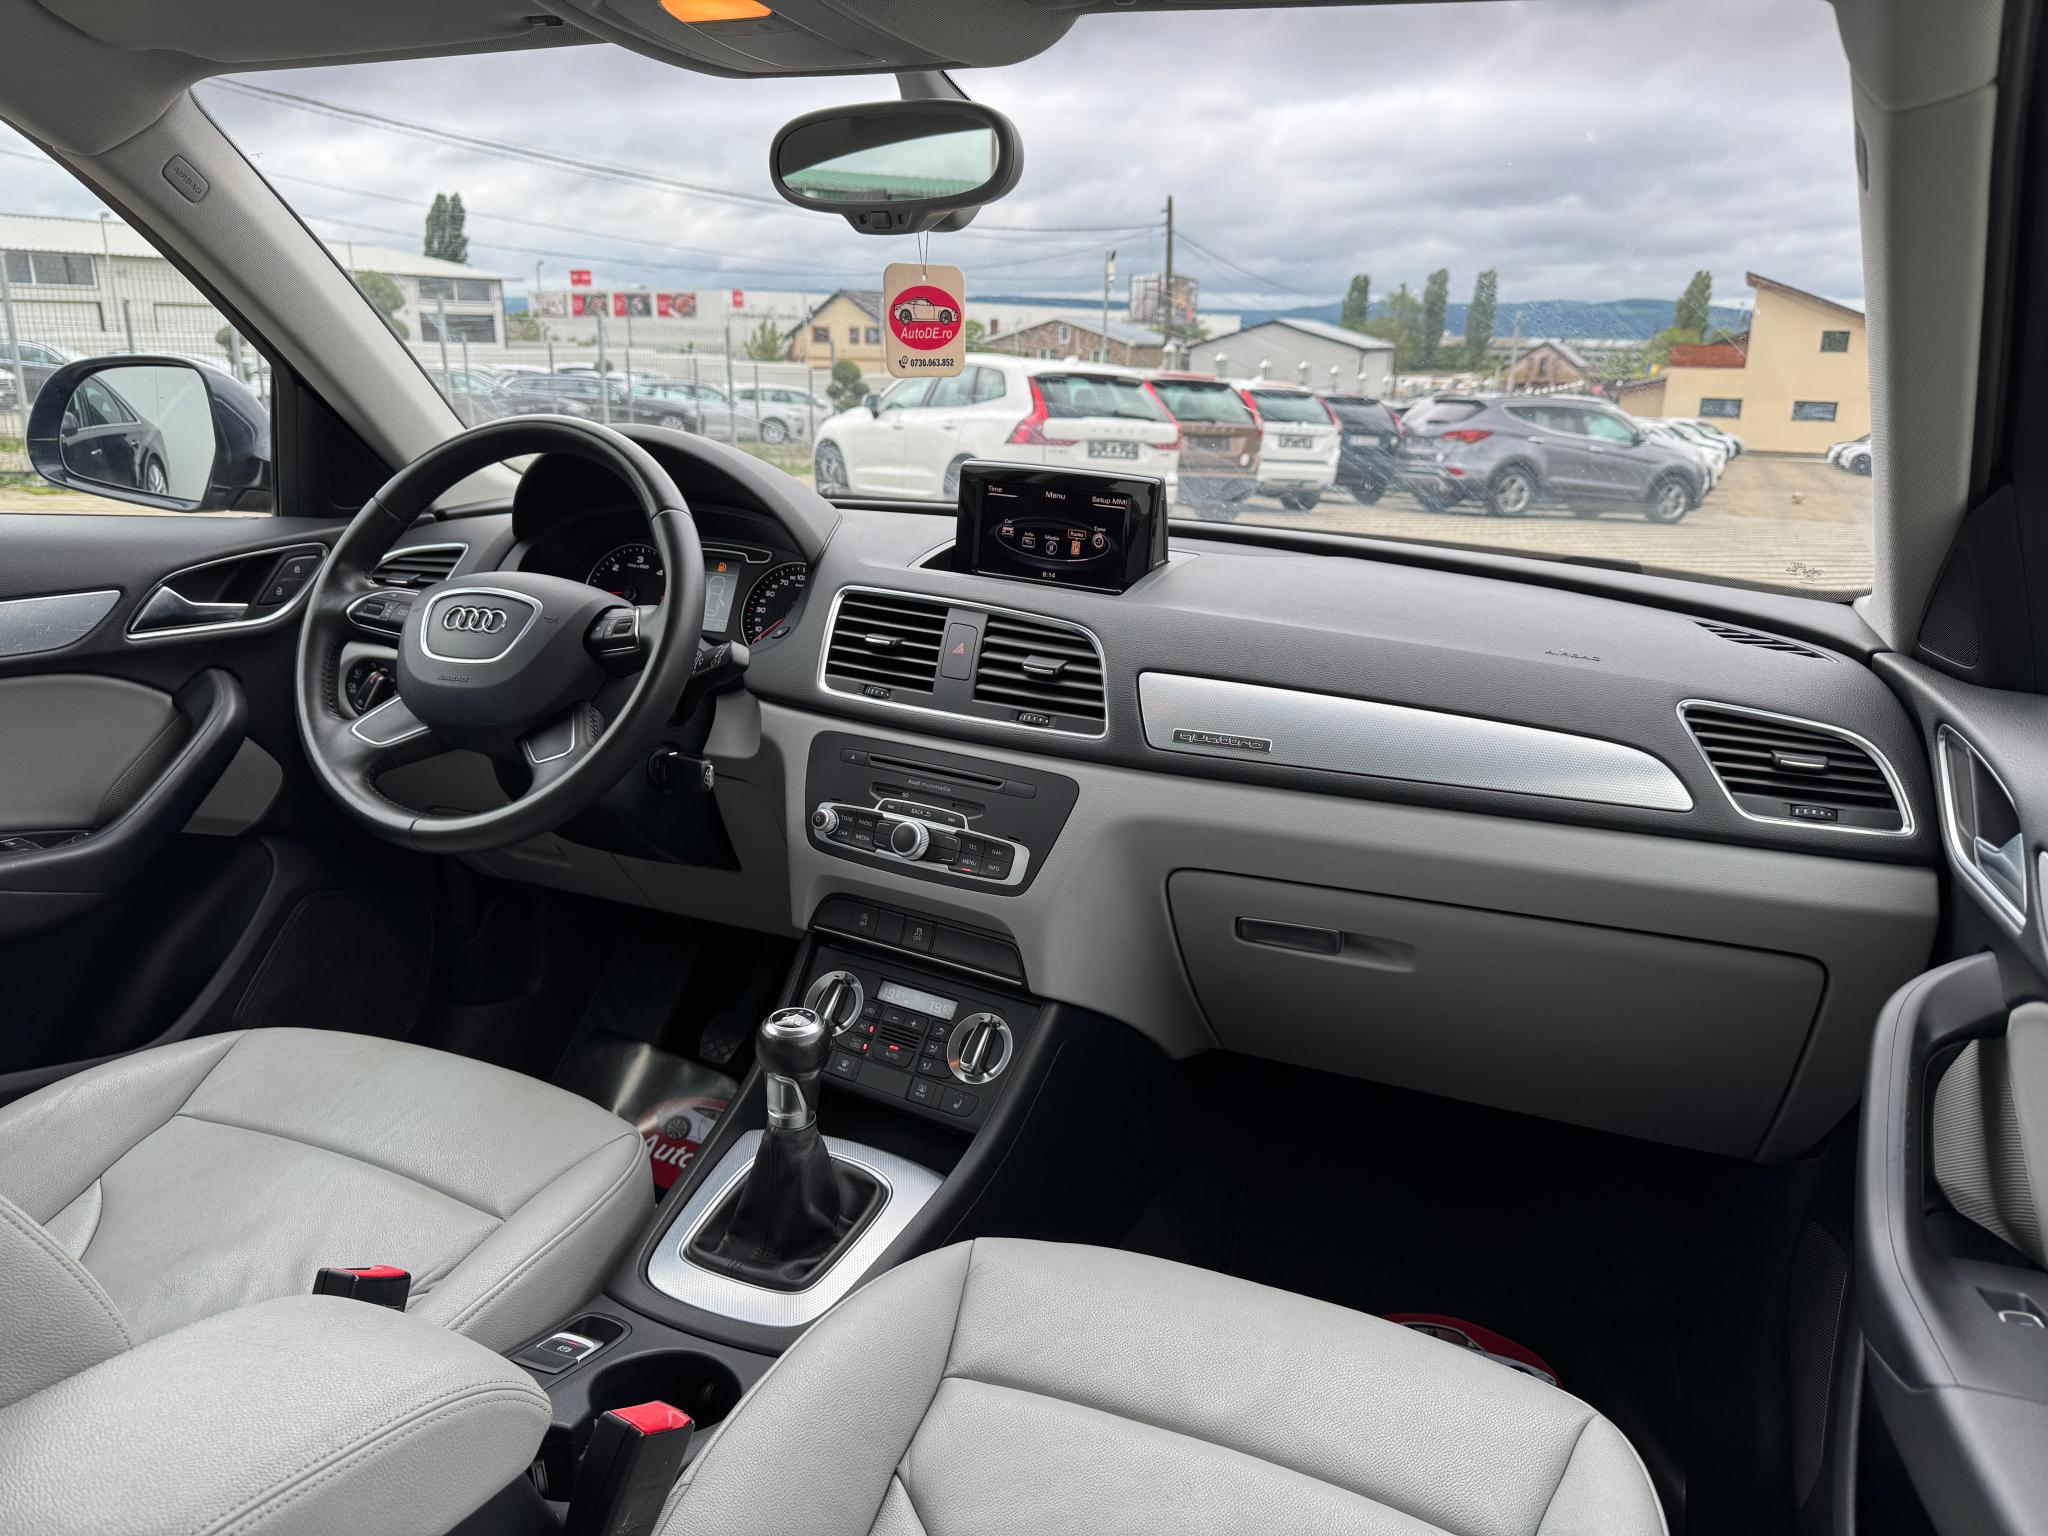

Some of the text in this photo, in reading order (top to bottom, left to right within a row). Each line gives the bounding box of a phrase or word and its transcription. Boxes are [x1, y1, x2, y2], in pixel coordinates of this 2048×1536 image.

[173, 167, 202, 194] AIRBAG
[900, 326, 953, 339] AutoDE.ro
[910, 358, 954, 367] 0730.063.852
[988, 485, 1003, 493] Time
[1045, 491, 1066, 500] Menu
[1091, 495, 1111, 505] Setup
[1094, 525, 1107, 533] Tone
[1044, 534, 1060, 542] Media
[636, 555, 644, 563] 3
[612, 563, 620, 572] 2
[1042, 570, 1056, 579] 8:14
[1180, 732, 1264, 749] quattro
[911, 808, 924, 816] BACK
[859, 818, 873, 827] RADIO
[855, 833, 870, 841] MEDIA
[992, 848, 1002, 856] NAV
[962, 858, 977, 866] MENU
[988, 864, 1000, 872] INFO
[885, 1051, 899, 1060] AUTO
